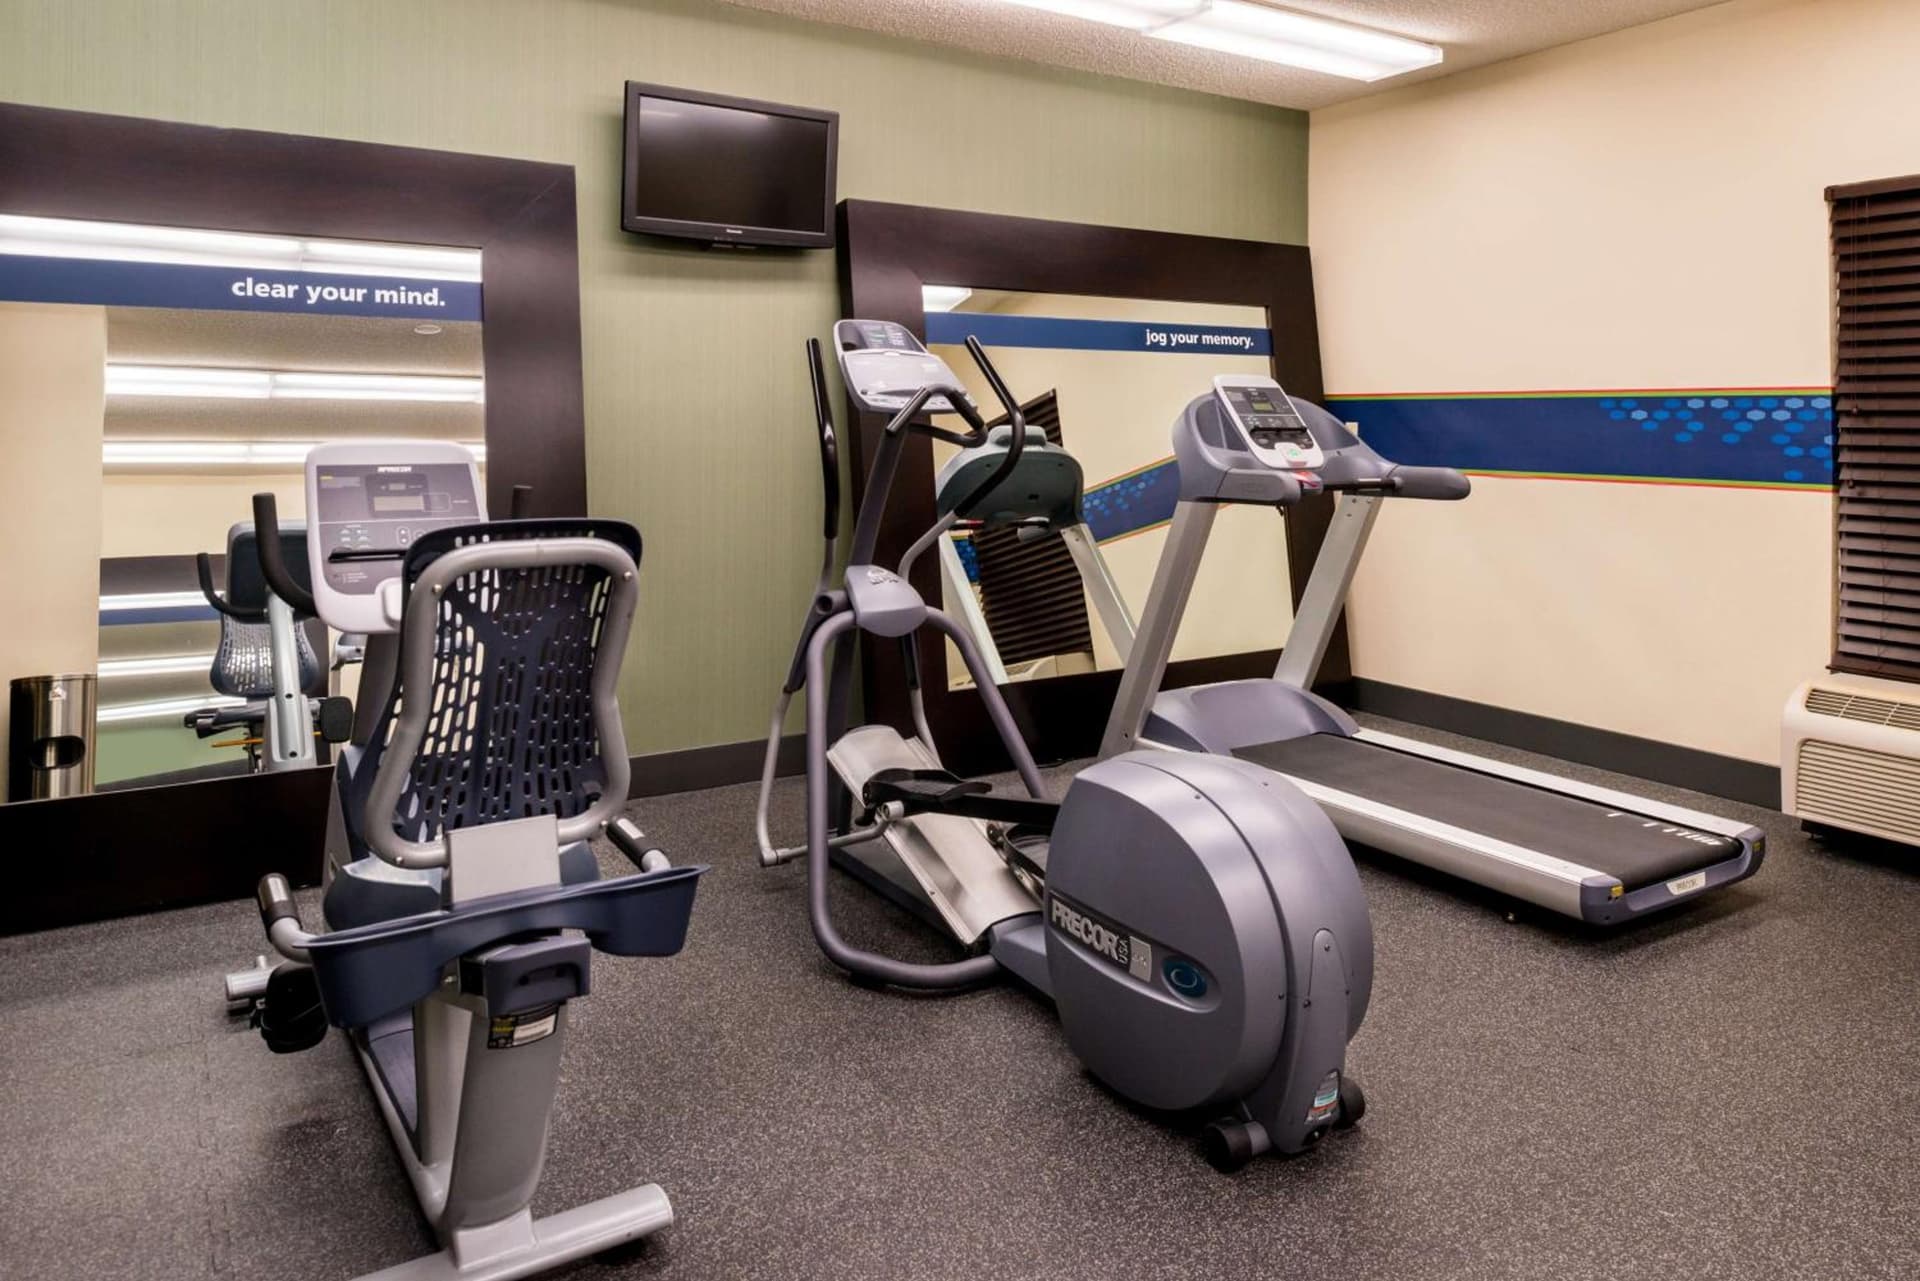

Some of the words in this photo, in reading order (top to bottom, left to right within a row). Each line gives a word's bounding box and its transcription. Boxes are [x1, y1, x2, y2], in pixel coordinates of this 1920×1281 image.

[231, 277, 299, 298] clear
[306, 285, 367, 304] your
[374, 286, 446, 306] mind.
[1146, 329, 1167, 345] jog
[1170, 333, 1199, 346] your
[1201, 334, 1254, 349] memory.
[1052, 900, 1119, 960] PRECOR
